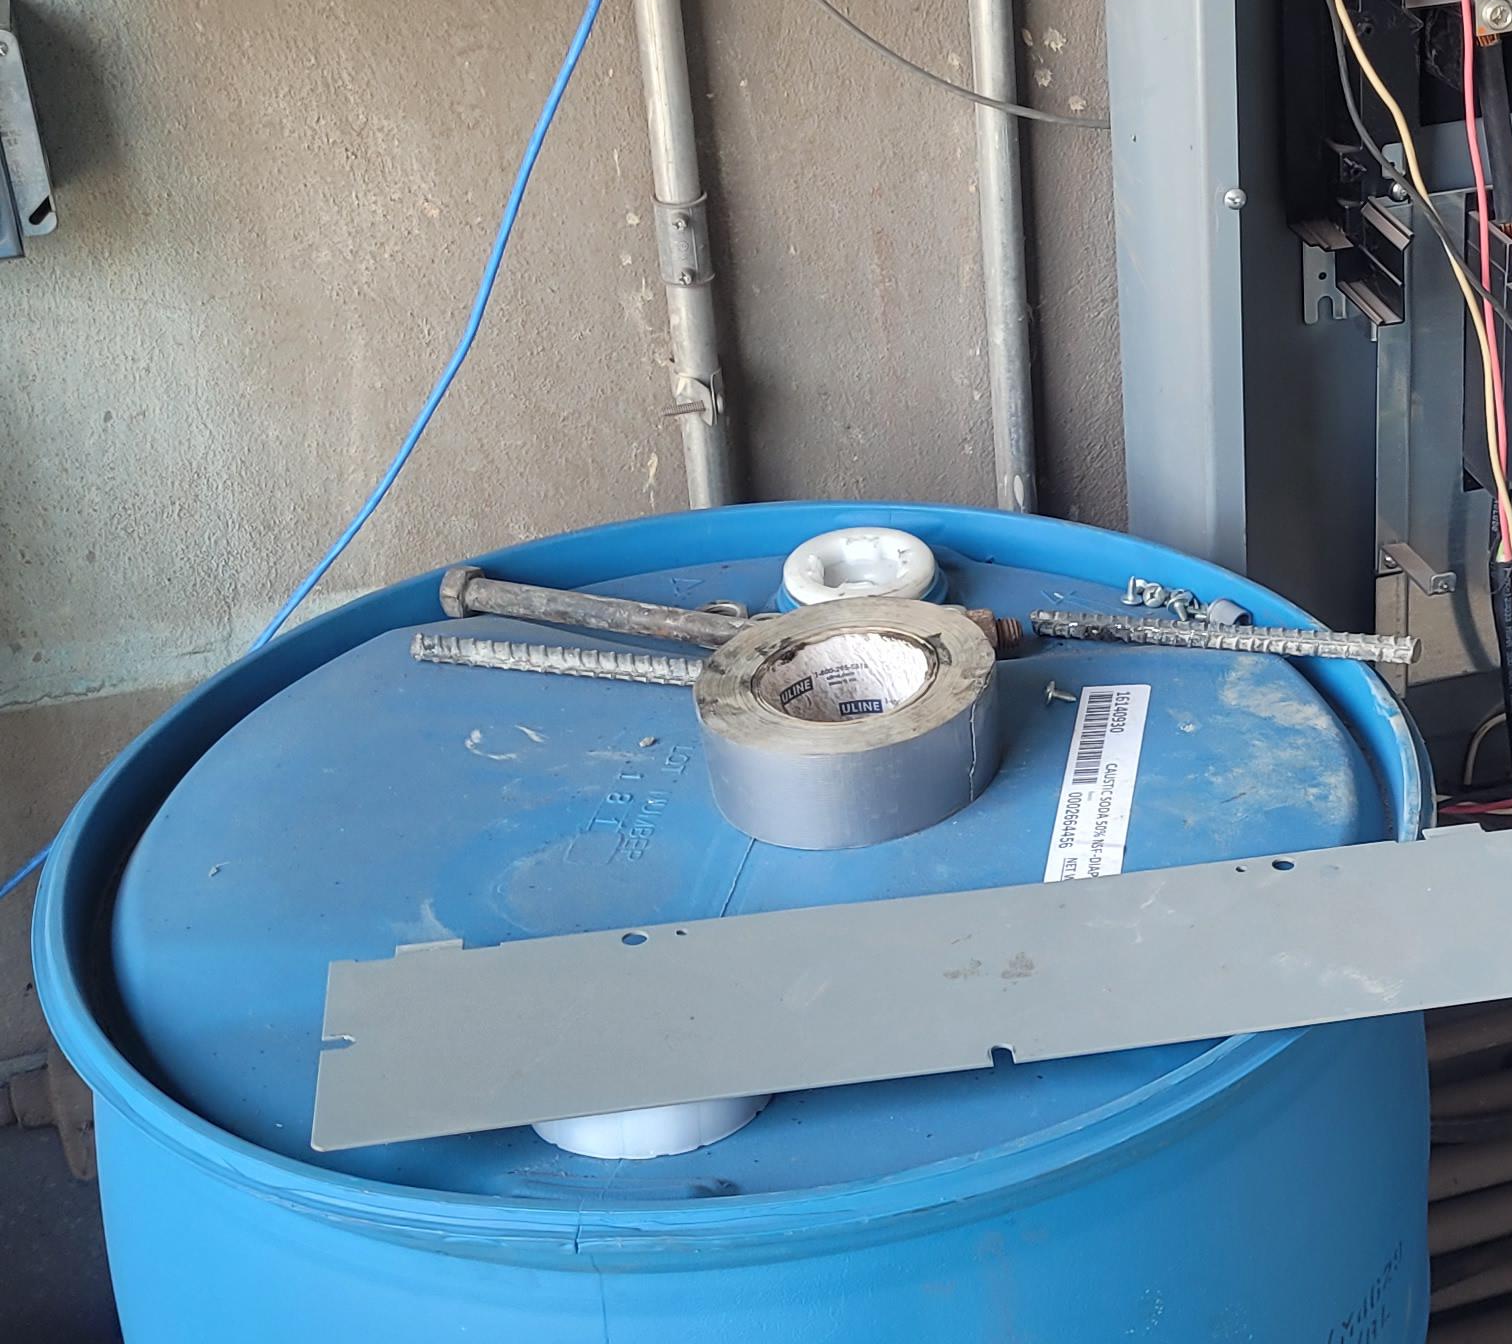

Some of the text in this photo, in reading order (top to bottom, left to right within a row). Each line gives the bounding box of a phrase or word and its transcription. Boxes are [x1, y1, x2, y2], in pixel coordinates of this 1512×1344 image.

[781, 679, 812, 702] ULINE
[841, 701, 881, 714] ULINE
[1110, 691, 1130, 733] 16140930
[660, 745, 695, 774] LOT
[1102, 763, 1118, 796] CAUSTIC
[1058, 792, 1083, 849] 0002664456
[1098, 796, 1113, 820] SODA
[620, 791, 670, 862] NUMBER
[1094, 821, 1107, 838] 50%
[1066, 858, 1079, 872] NET
